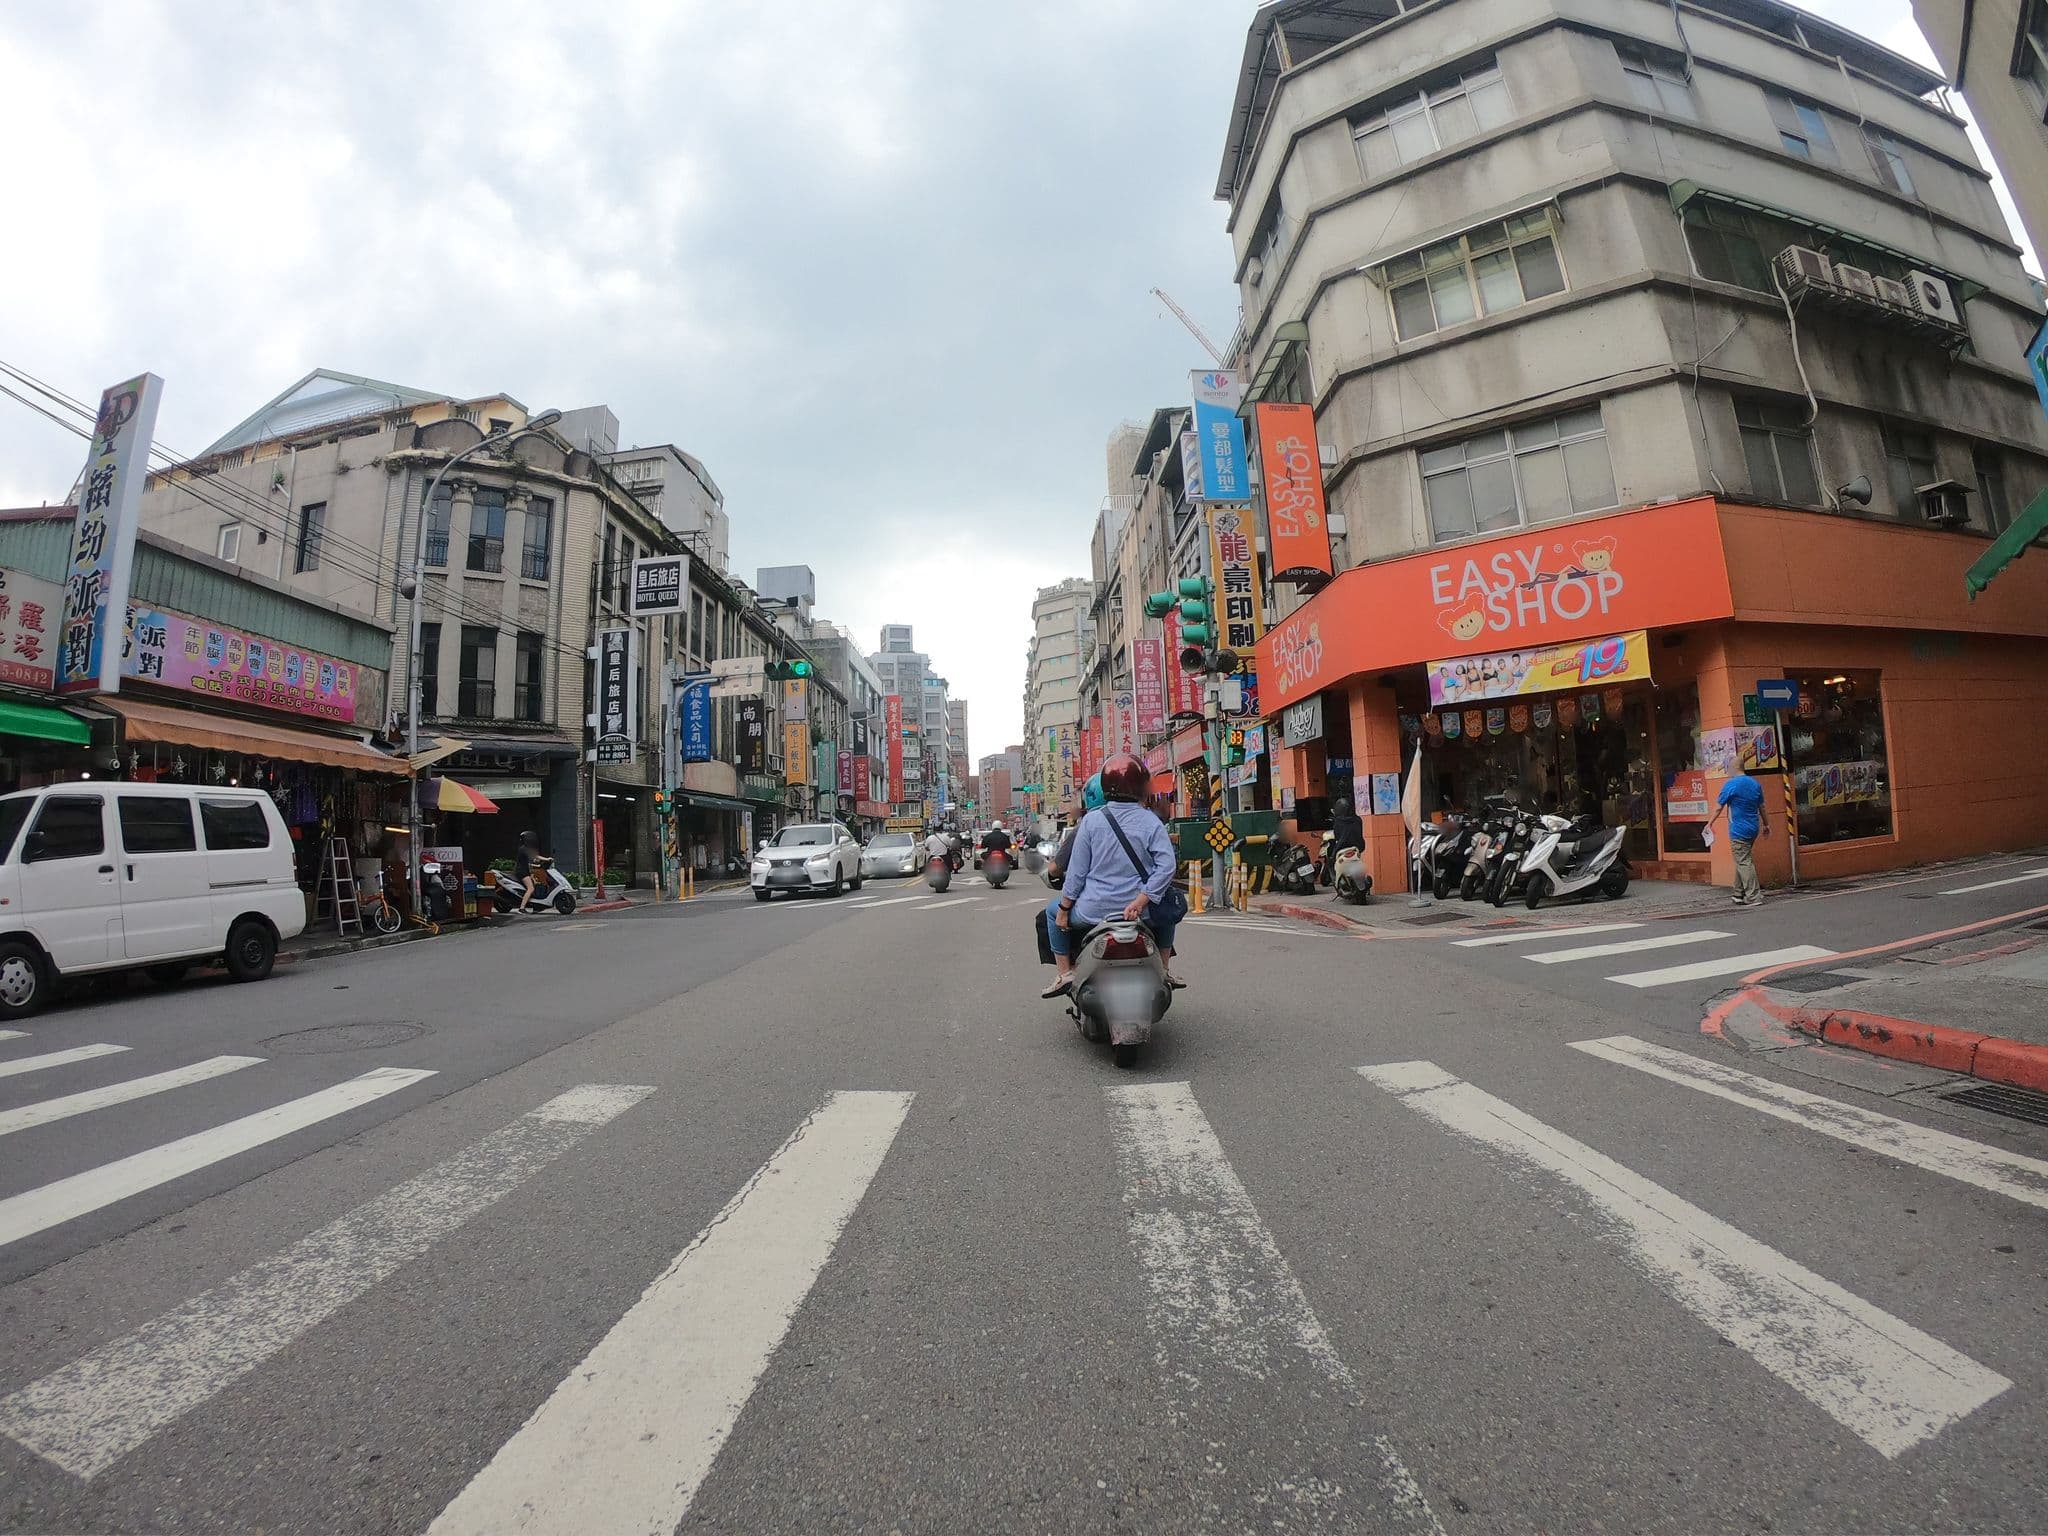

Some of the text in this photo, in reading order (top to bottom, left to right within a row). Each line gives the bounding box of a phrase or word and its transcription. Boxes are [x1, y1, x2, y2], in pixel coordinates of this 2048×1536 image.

[1211, 422, 1236, 492] 曼都髮型
[1284, 435, 1316, 508] SHOP
[1271, 472, 1300, 538] EASY
[64, 463, 117, 678] 繽紛派對
[637, 566, 679, 589] 皇后旅店
[637, 590, 679, 603] HOTEL QUEEN
[1303, 568, 1321, 576] SHOP
[1430, 545, 1544, 605] EASY
[1486, 570, 1624, 632] SHOP
[138, 623, 166, 678] 派對
[1272, 619, 1301, 668] EASY
[1286, 637, 1323, 688] SHOP
[608, 651, 621, 714] 皇后旅店
[690, 684, 703, 743] 福食品公司
